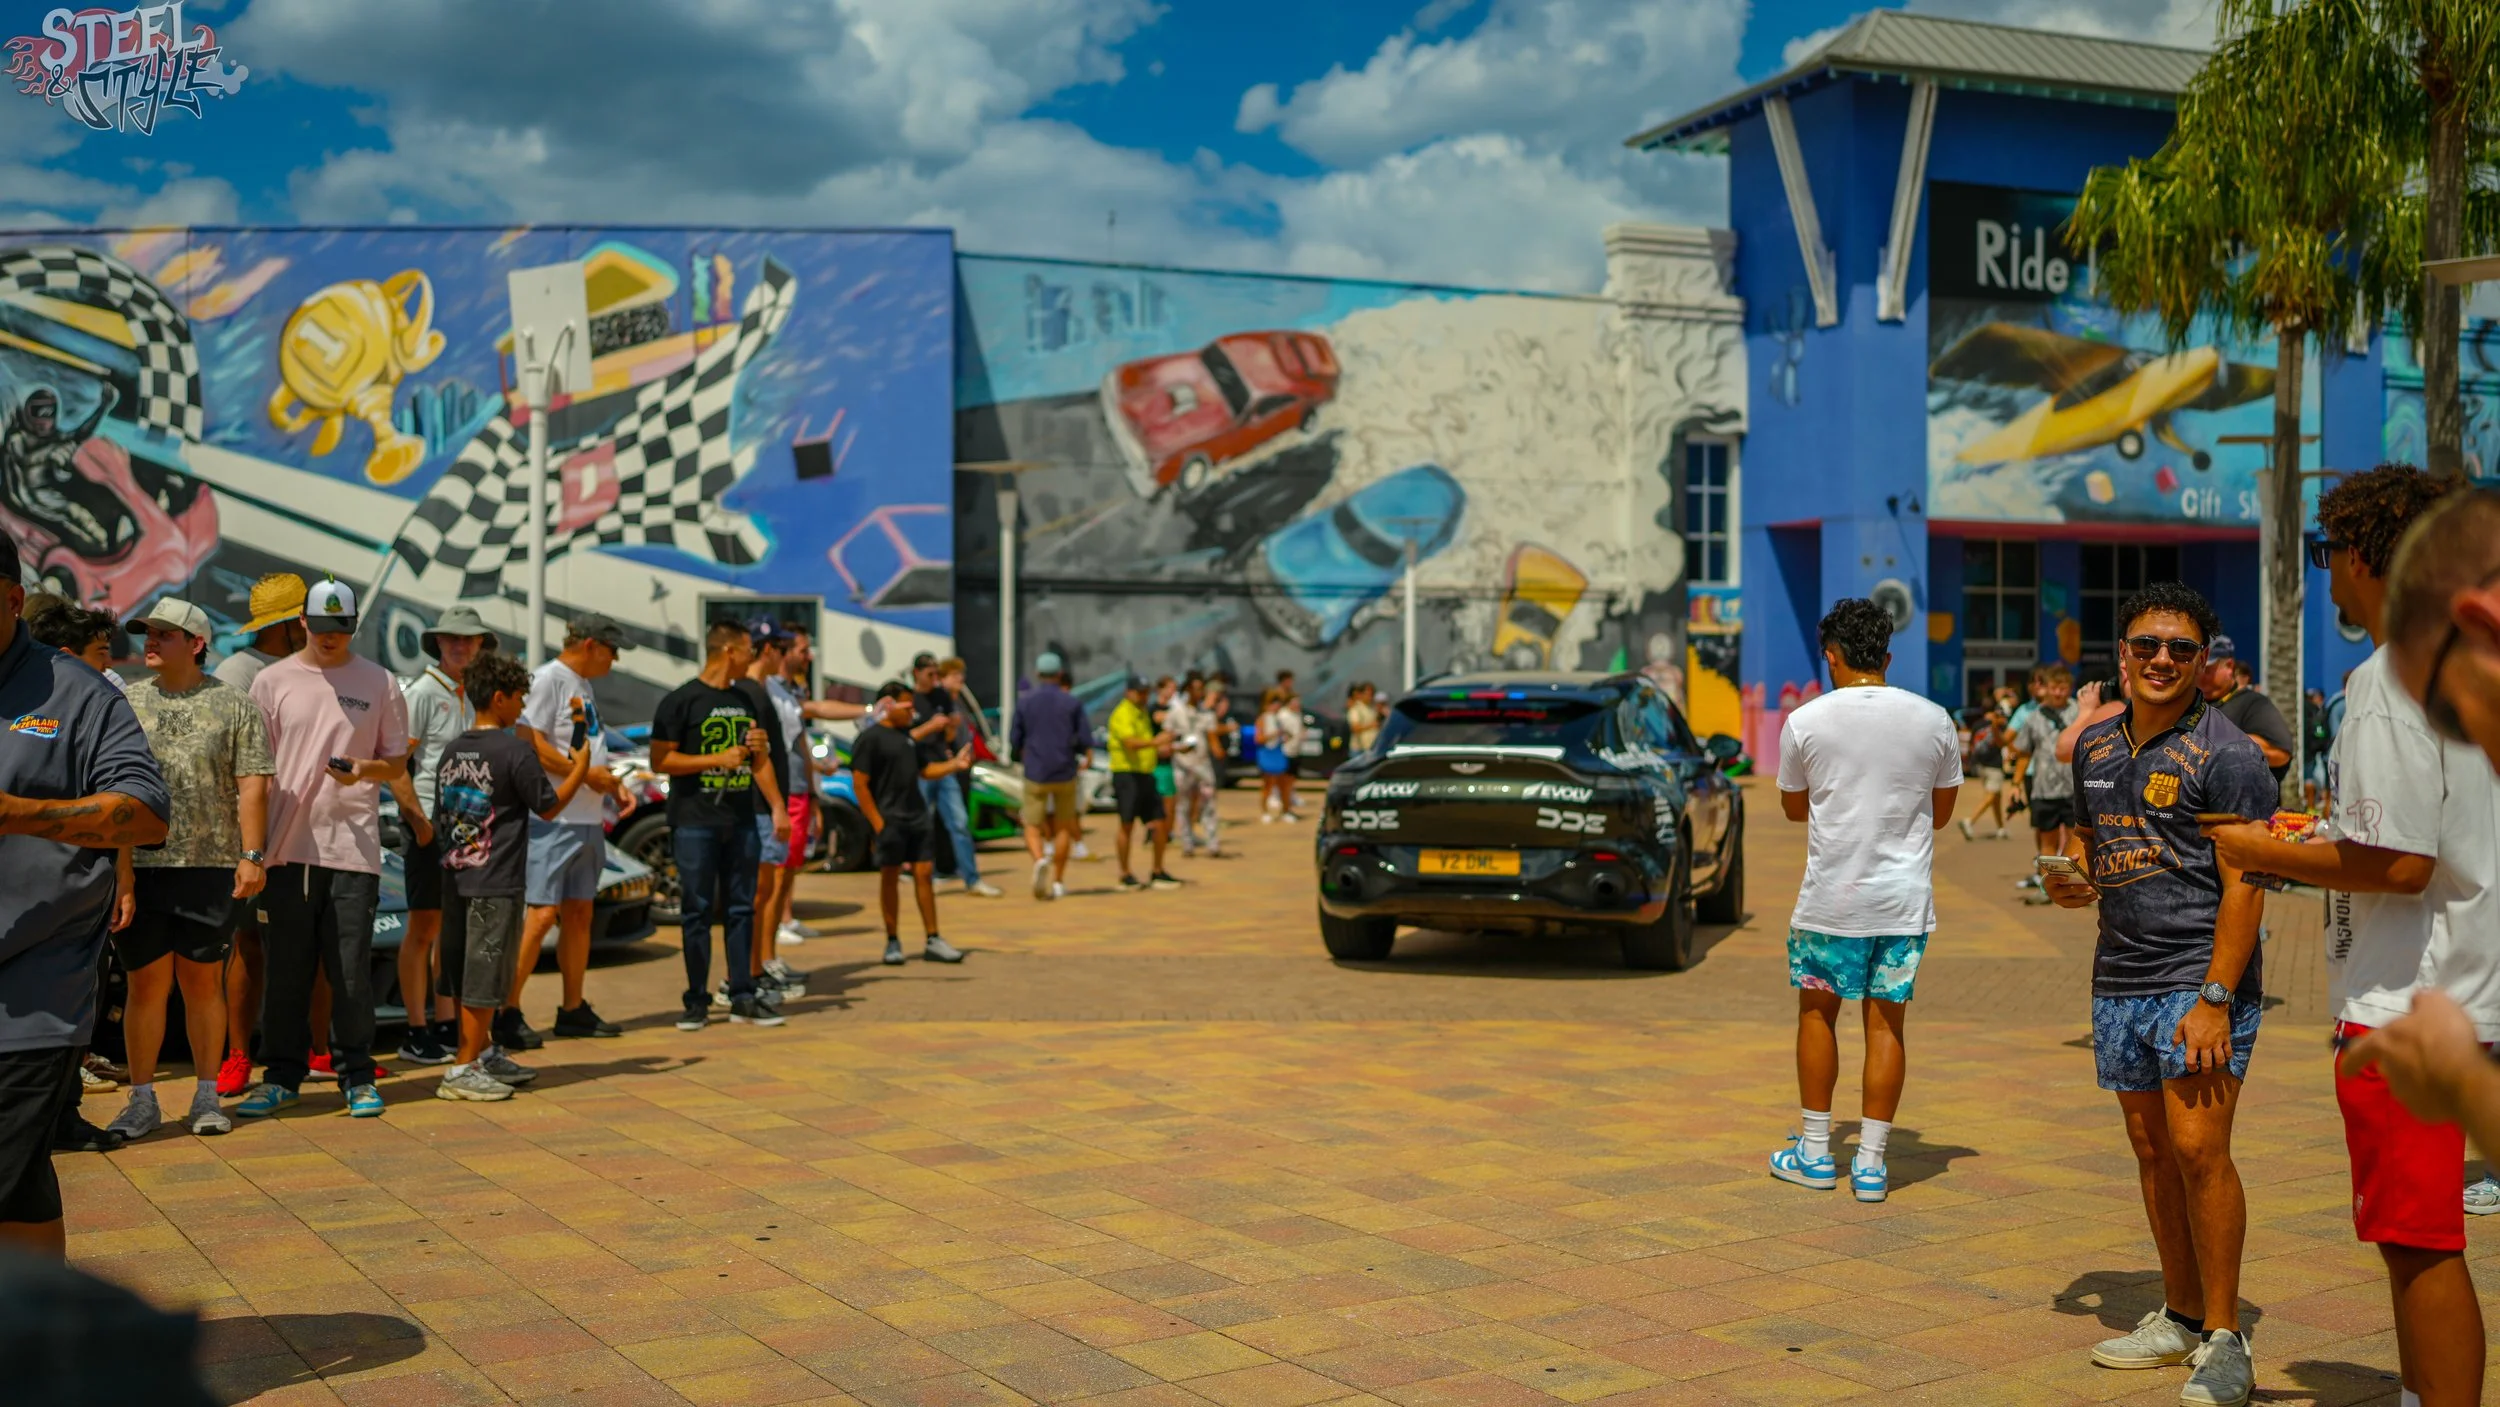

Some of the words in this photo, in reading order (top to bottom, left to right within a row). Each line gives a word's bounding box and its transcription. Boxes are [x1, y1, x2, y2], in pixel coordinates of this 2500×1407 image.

[1976, 219, 2070, 294] Ride
[2181, 487, 2221, 519] Gift
[1539, 784, 1594, 804] EVOLV
[2083, 779, 2115, 789] marathon
[2098, 813, 2147, 829] DISCOVR
